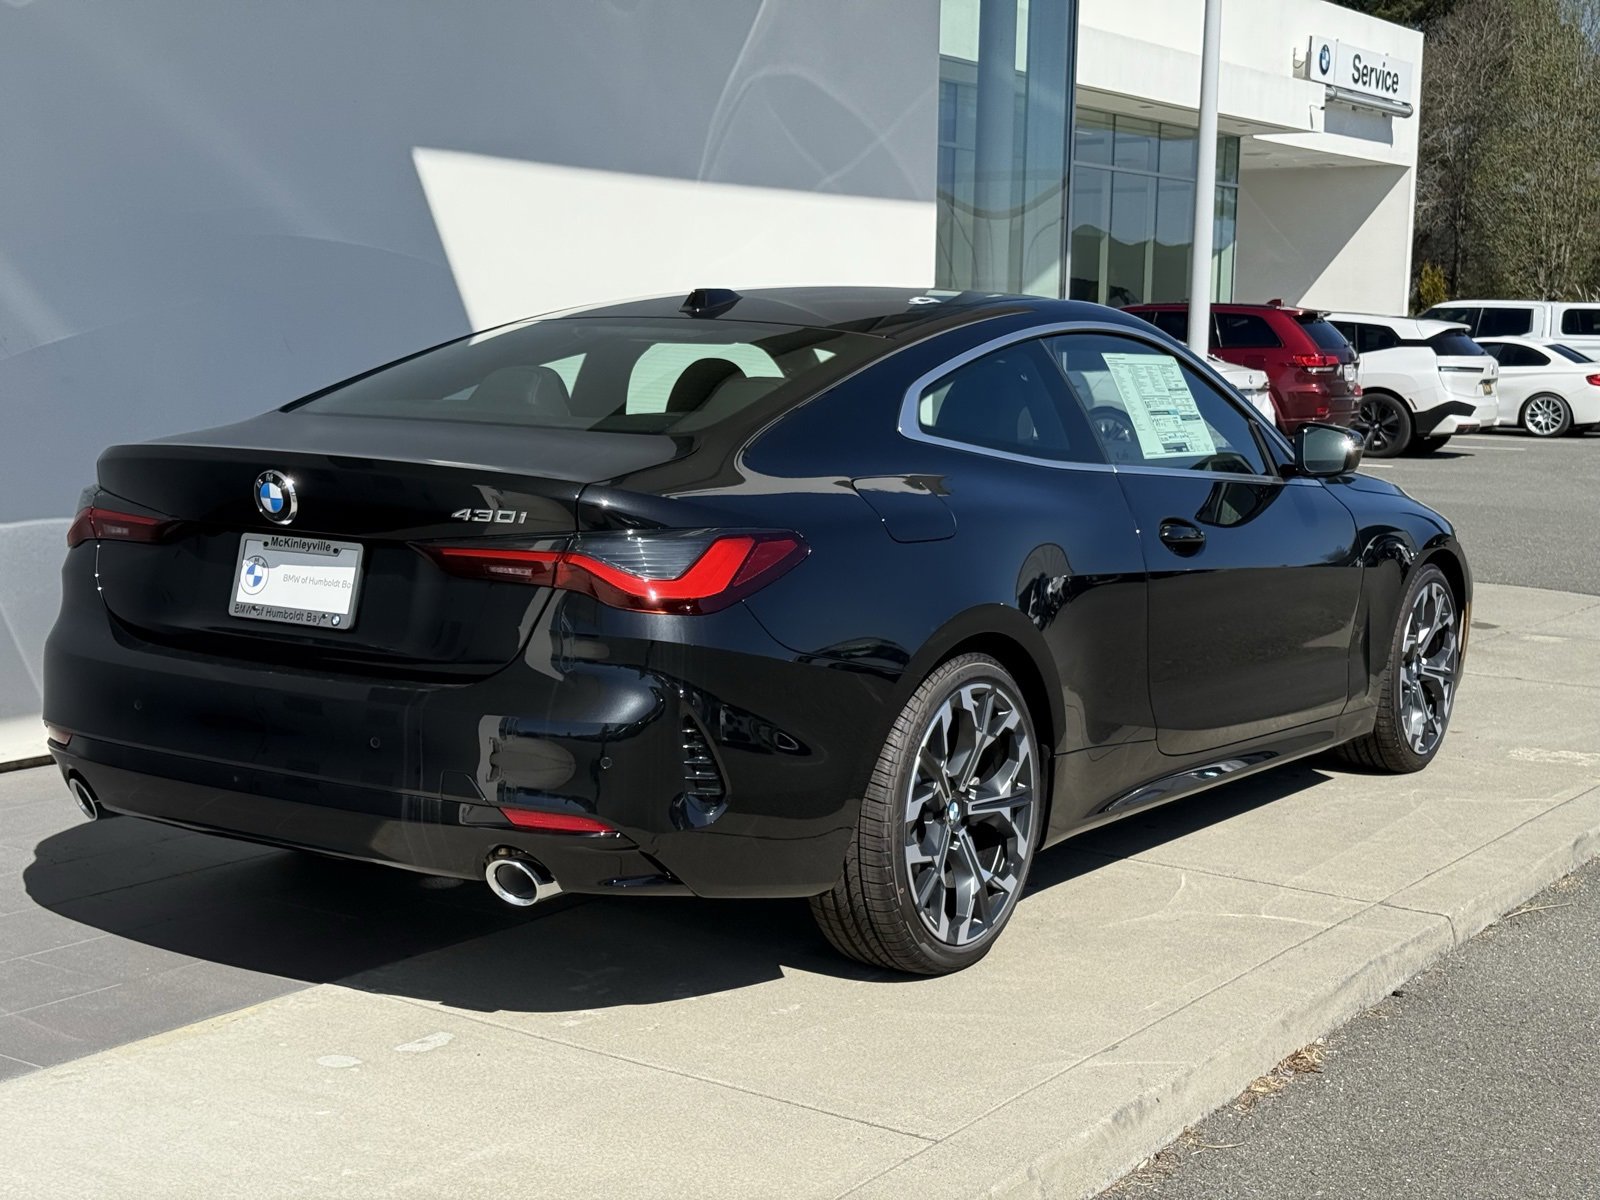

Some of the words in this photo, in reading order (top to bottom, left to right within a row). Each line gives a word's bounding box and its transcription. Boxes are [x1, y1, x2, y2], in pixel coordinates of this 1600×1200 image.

[1351, 53, 1399, 93] Service
[451, 508, 528, 524] 430i
[270, 536, 331, 552] McKinleyville
[282, 573, 300, 583] BMW
[300, 576, 308, 584] of
[308, 576, 341, 588] Humboldt
[234, 603, 253, 614] BMW
[265, 608, 305, 621] Humboldt
[306, 612, 322, 625] Bay
